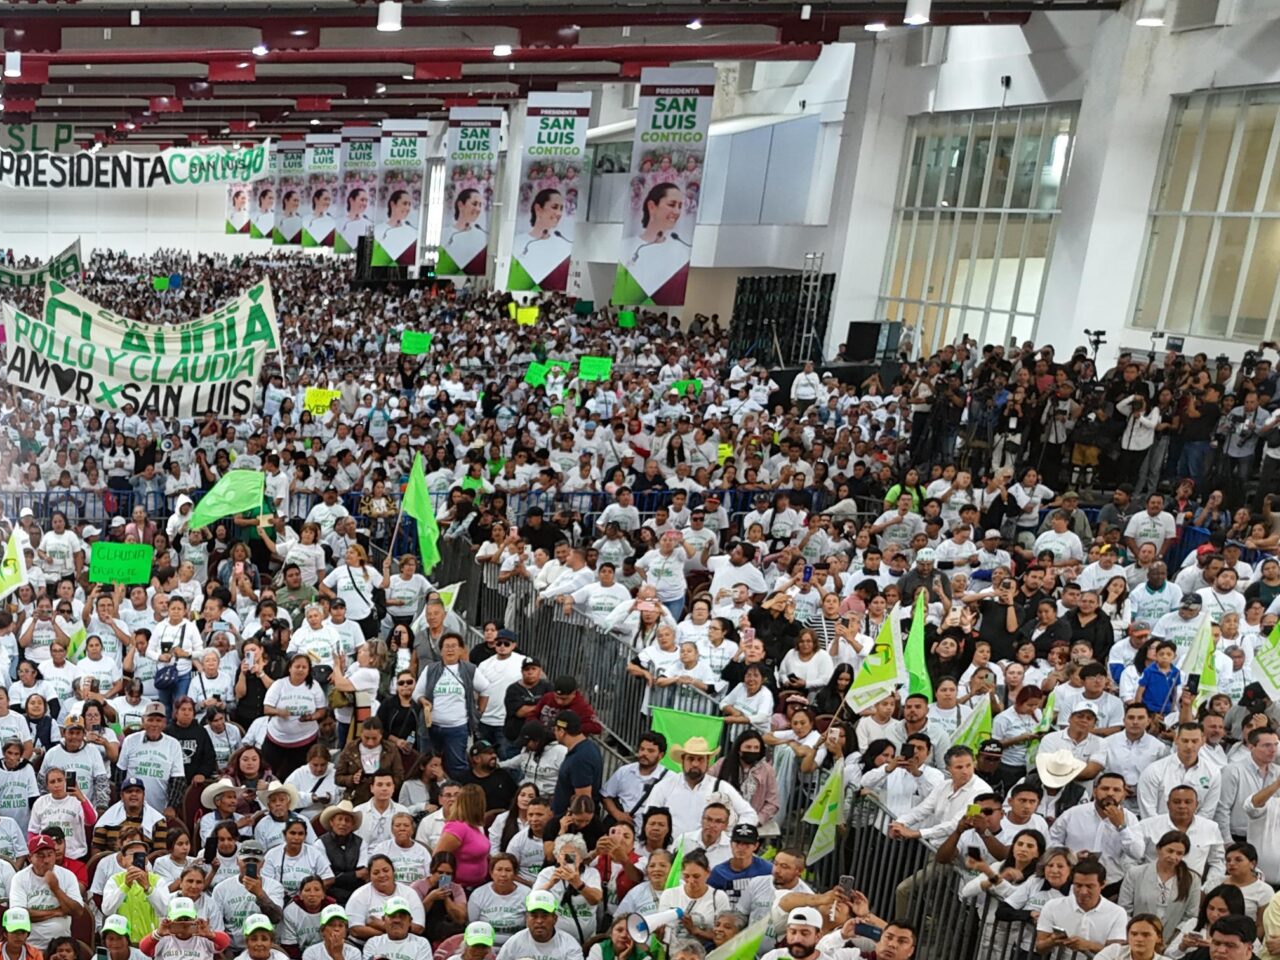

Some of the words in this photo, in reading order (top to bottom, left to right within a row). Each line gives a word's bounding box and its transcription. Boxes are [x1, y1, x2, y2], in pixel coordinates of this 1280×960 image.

[655, 87, 700, 95] PRESIDENTA
[654, 97, 698, 113] SAN
[539, 117, 575, 130] SAN
[651, 115, 696, 131] LUIS
[460, 128, 490, 139] SAN
[537, 131, 574, 145] LUIS
[640, 131, 703, 143] CONTIGO
[350, 142, 373, 152] SAN
[392, 137, 418, 147] SAN
[458, 140, 490, 151] LUIS
[314, 147, 334, 156] SAN
[349, 151, 373, 160] LUIS
[390, 147, 417, 158] LUIS
[451, 152, 495, 160] CONTIGO
[528, 146, 580, 155] CONTIGO
[313, 155, 334, 164] LUIS
[384, 158, 422, 167] CONTIGO
[15, 312, 95, 370] POLLO
[105, 351, 123, 376] Y
[129, 348, 255, 384] CLAUDIA
[122, 382, 182, 416] SAN
[192, 380, 253, 418] LUIS
[135, 766, 150, 776] SAN
[150, 769, 164, 779] LUIS
[0, 799, 13, 809] SAN
[14, 799, 26, 808] LUIS
